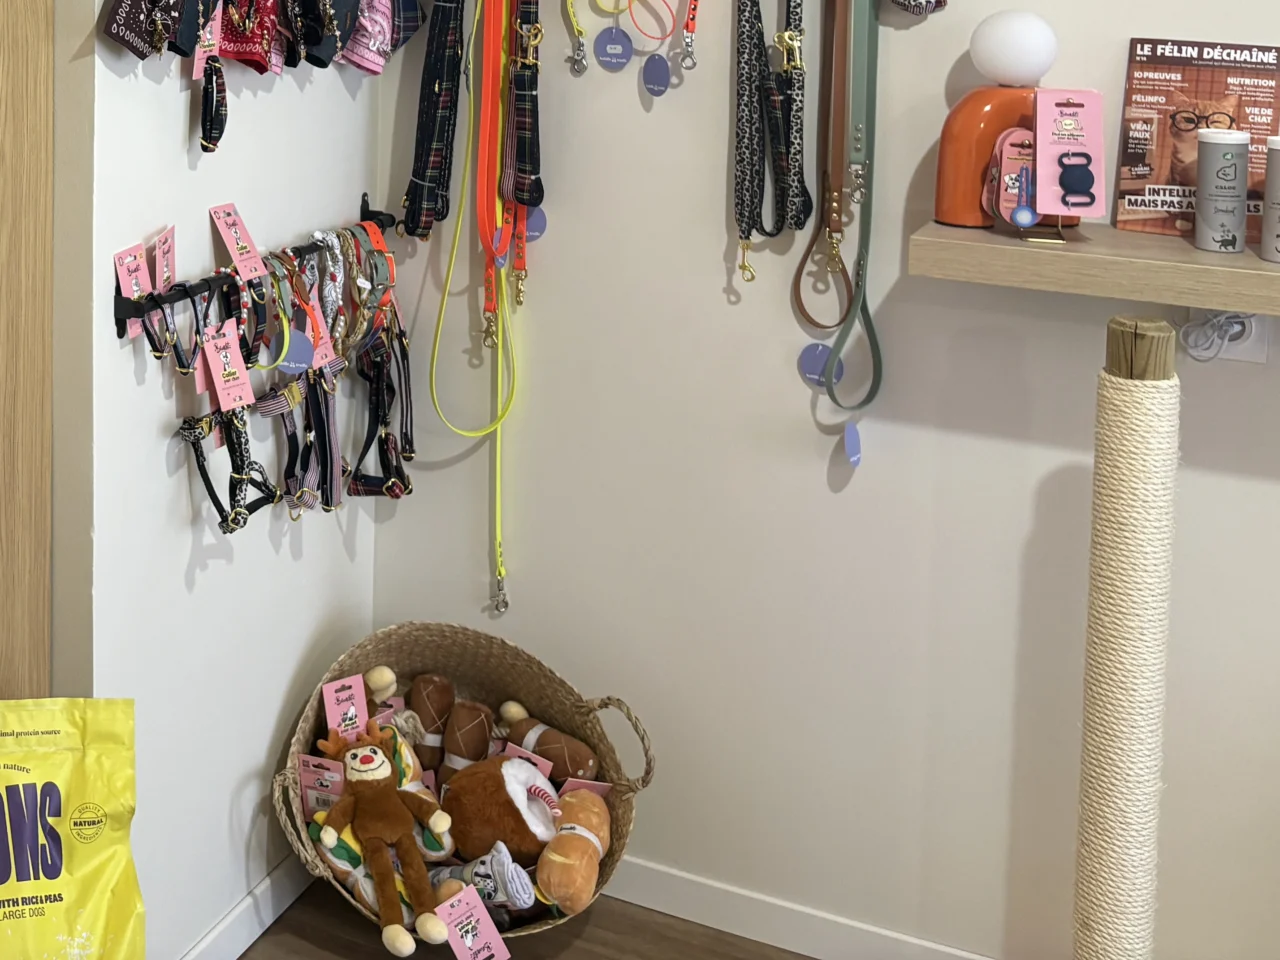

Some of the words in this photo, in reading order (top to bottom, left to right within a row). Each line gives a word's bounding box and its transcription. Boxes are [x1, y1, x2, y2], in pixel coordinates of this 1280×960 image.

[1136, 44, 1152, 55] LE
[1157, 42, 1198, 58] FÉLIN
[1203, 45, 1278, 64] DÉCHAÎNÉ
[1144, 72, 1182, 80] PREUVES
[1227, 77, 1275, 87] NUTRITION
[1132, 94, 1166, 103] FÉLINFO
[1245, 106, 1260, 114] VIE
[1260, 107, 1273, 115] DE
[1248, 115, 1273, 123] CHAT
[1130, 123, 1150, 131] VRAI
[1129, 131, 1150, 139] FAUX
[1127, 198, 1159, 208] MAIS
[1160, 199, 1183, 210] PAS
[15, 728, 39, 739] protein
[40, 728, 61, 737] source
[3, 763, 31, 774] nature
[78, 804, 100, 814] QUALITY
[73, 818, 104, 828] NATURAL
[28, 907, 46, 919] DOGS
